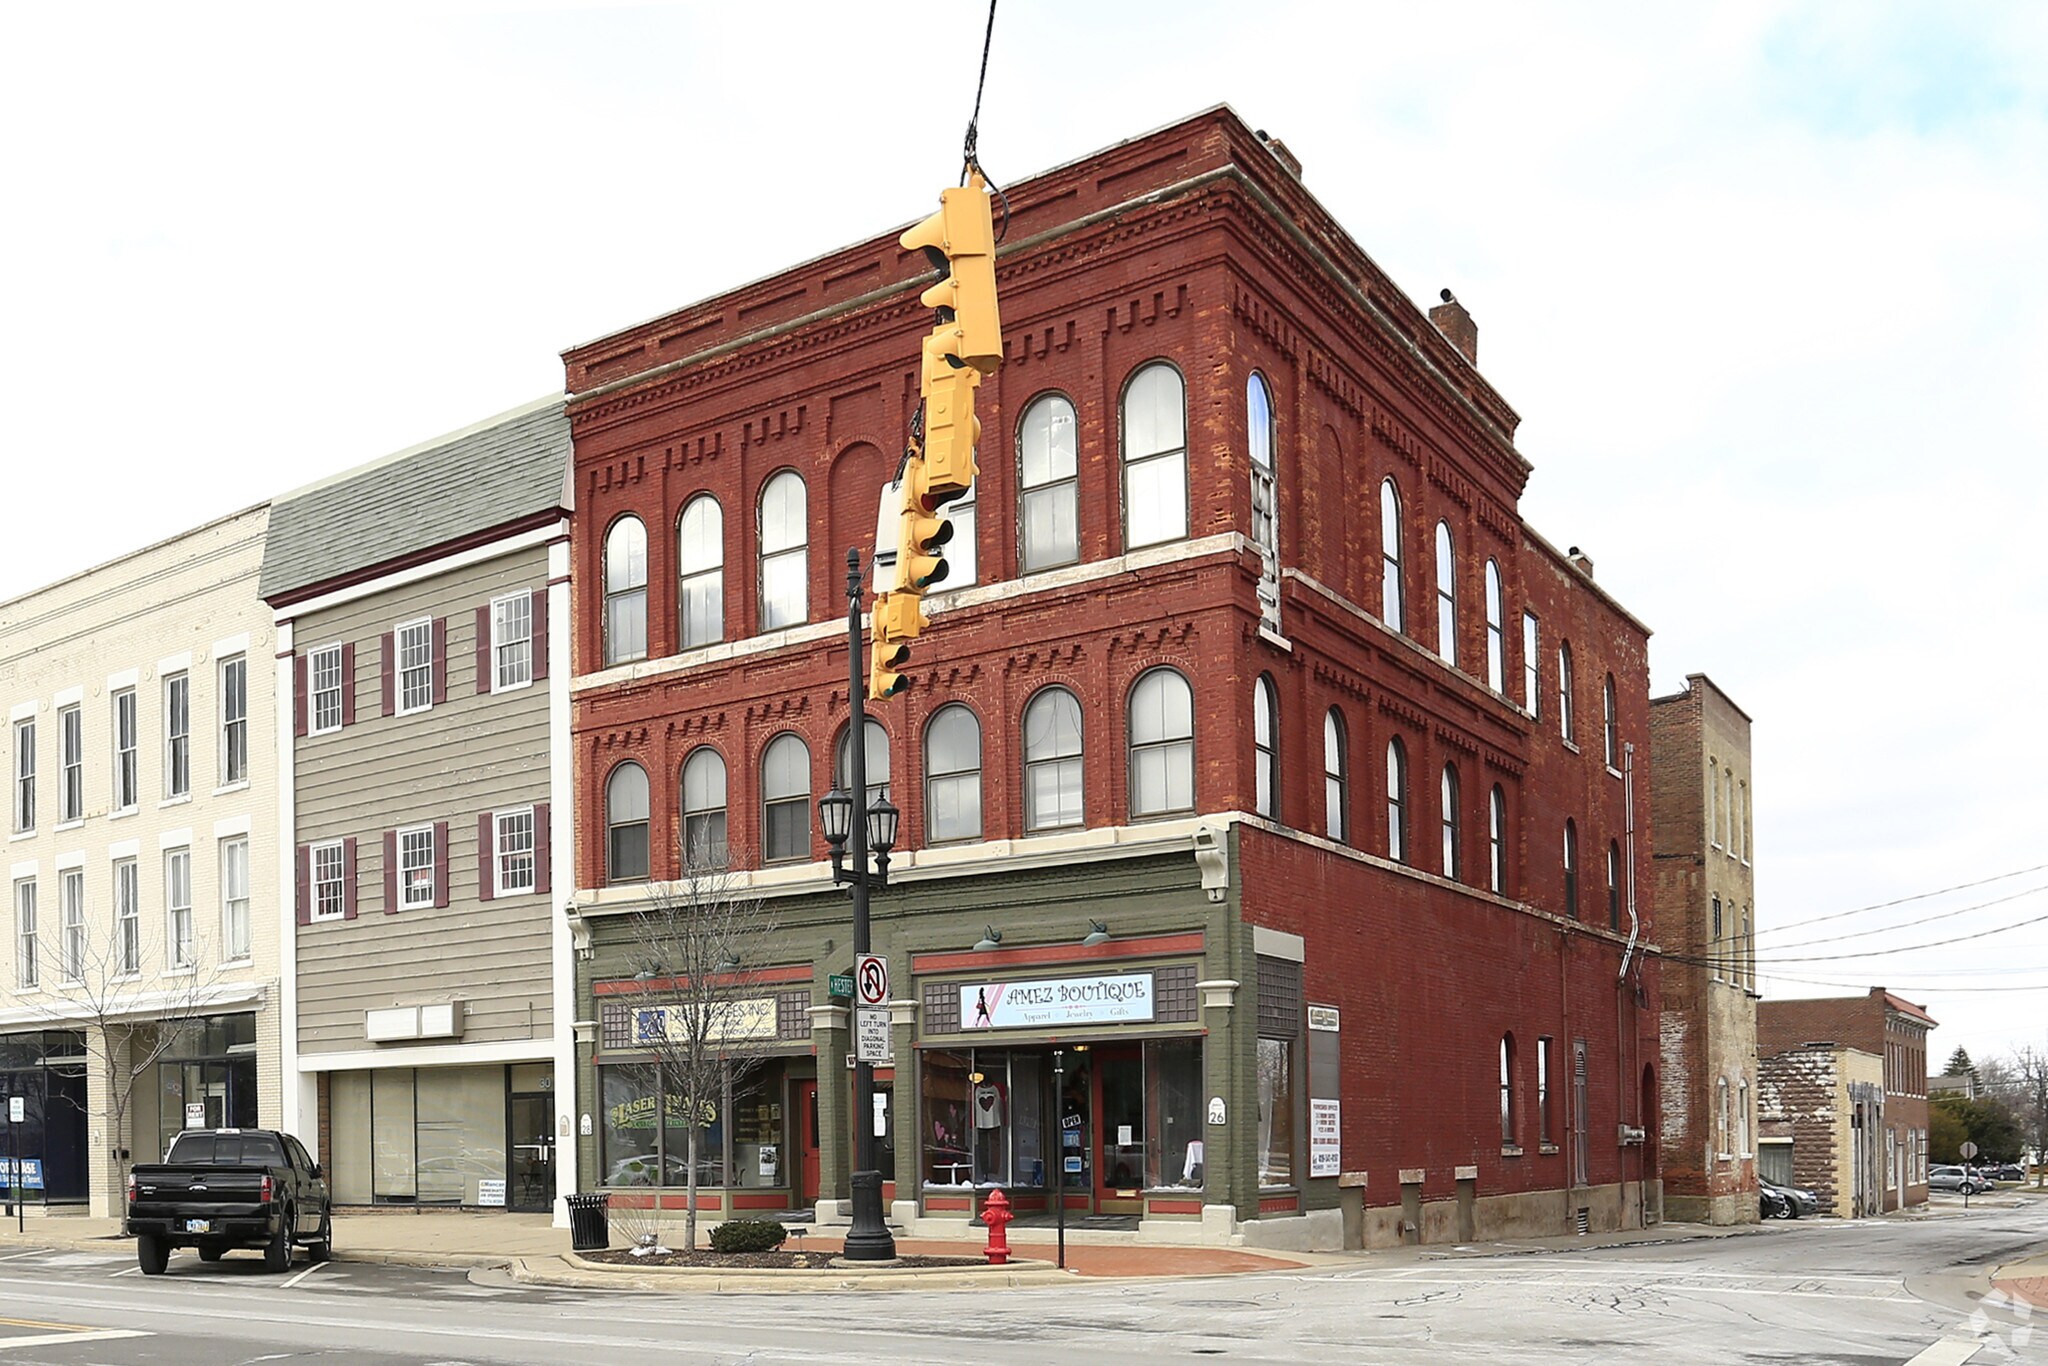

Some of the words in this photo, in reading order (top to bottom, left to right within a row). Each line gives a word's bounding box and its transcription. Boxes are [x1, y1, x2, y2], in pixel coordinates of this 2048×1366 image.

[834, 977, 853, 993] HESTER
[1006, 986, 1053, 1005] AMEZ
[1057, 981, 1146, 1002] BOUTIQUE
[1023, 1011, 1051, 1023] Apparel
[1066, 1010, 1093, 1020] Jewelry
[1109, 1007, 1129, 1017] Gifts
[873, 1020, 887, 1028] TURN
[539, 1077, 551, 1088] 30
[613, 1096, 656, 1123] LASER
[664, 1094, 717, 1122] IMAES
[1063, 1115, 1080, 1128] OPEN
[1210, 1111, 1224, 1123] 26
[582, 1124, 592, 1134] 28
